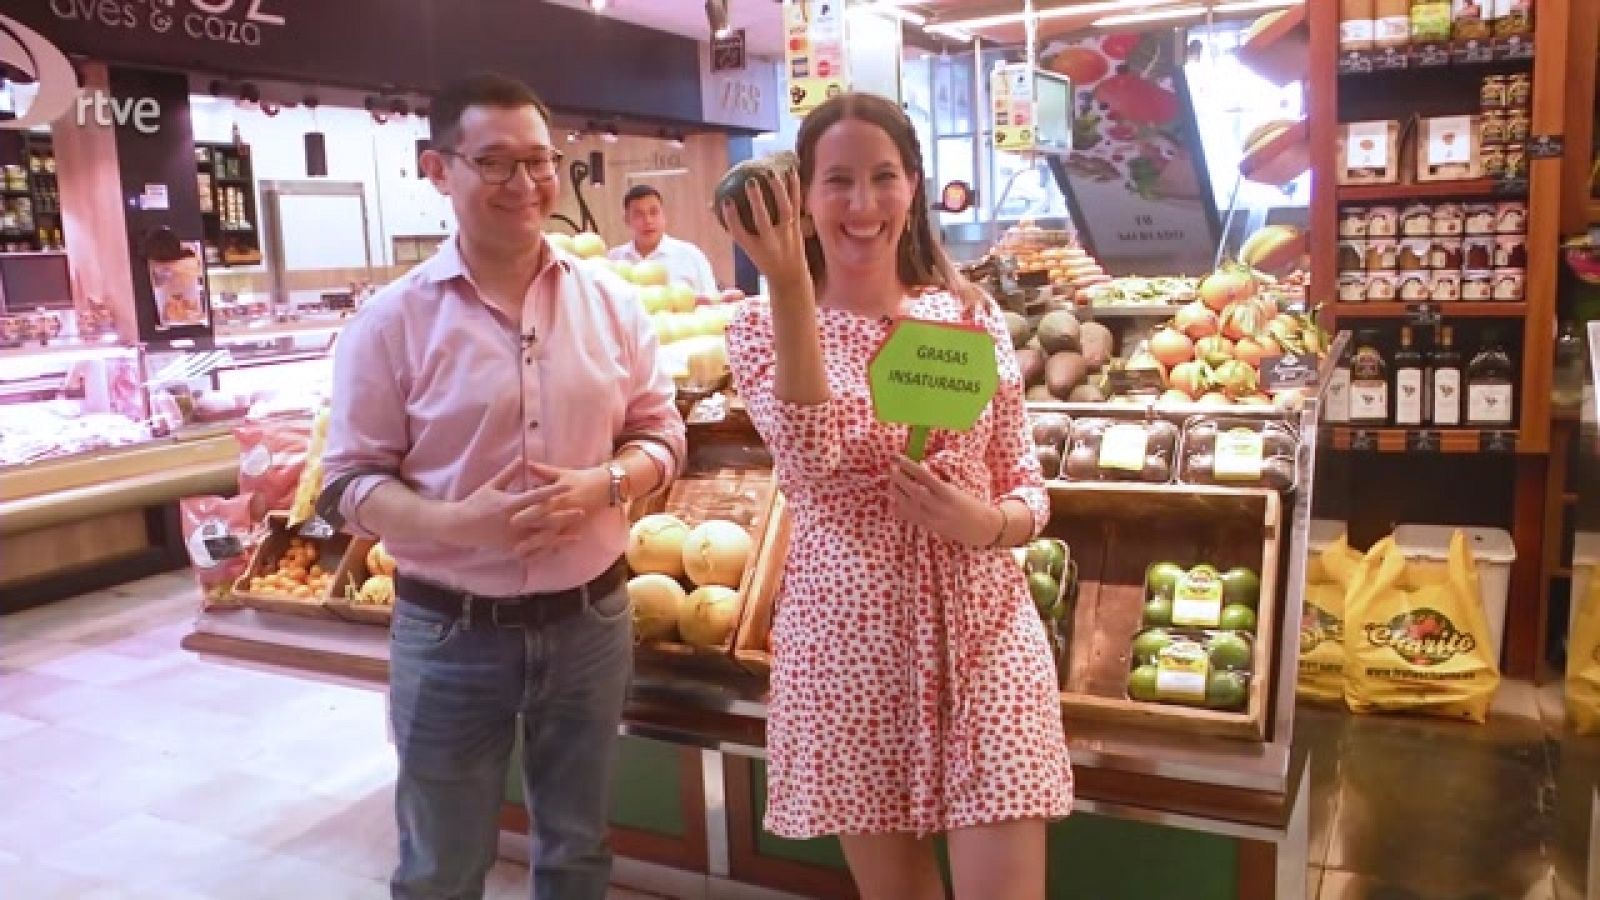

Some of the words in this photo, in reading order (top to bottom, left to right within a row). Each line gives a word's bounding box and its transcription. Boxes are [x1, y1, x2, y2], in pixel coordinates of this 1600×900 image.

[50, 0, 138, 29] aves
[150, 9, 174, 33] &
[184, 12, 262, 46] caza
[916, 344, 969, 366] GRASAS
[888, 369, 981, 394] INSATURADAS
[1363, 622, 1477, 658] Charito
